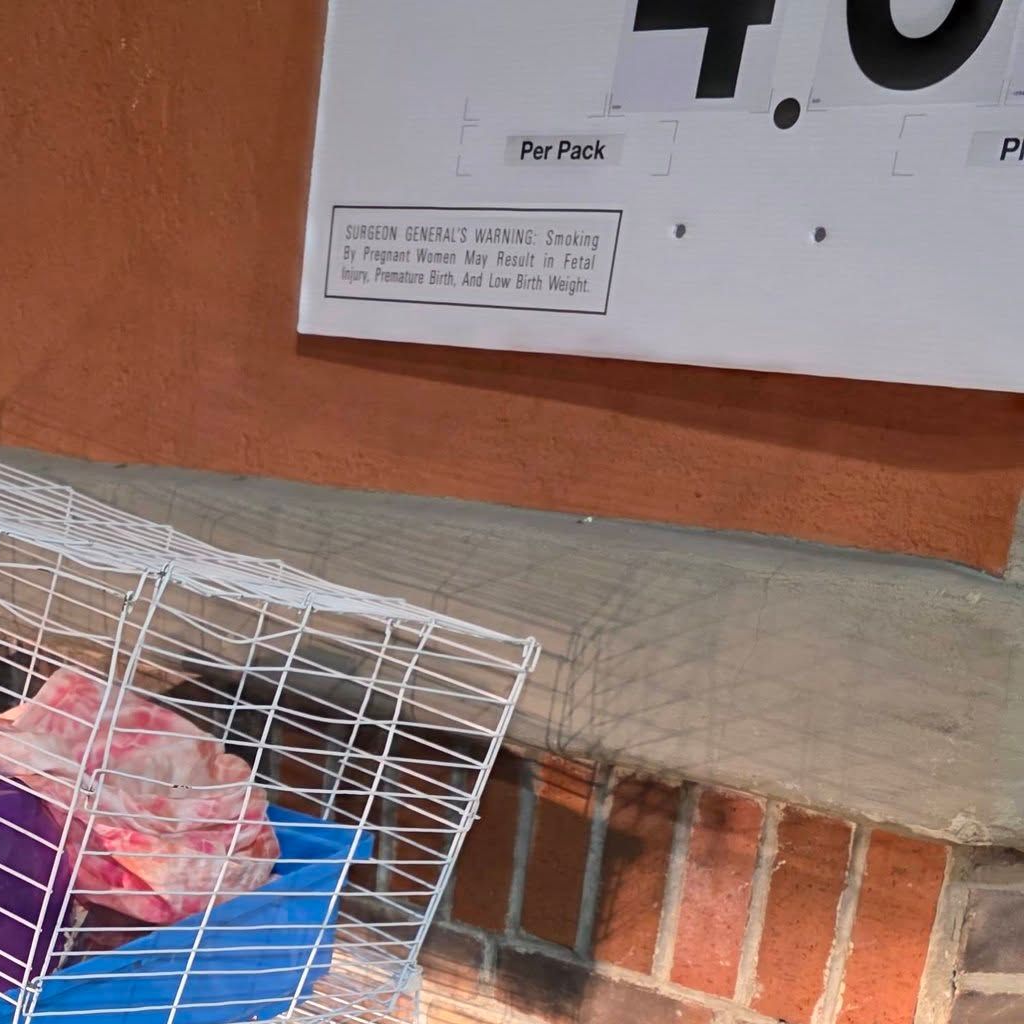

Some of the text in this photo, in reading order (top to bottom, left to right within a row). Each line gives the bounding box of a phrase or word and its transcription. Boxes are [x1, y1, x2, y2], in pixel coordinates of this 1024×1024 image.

[520, 139, 606, 161] Per Pack
[345, 224, 600, 251] SURGEON GENERAL'S WARNING: Smoking
[343, 246, 595, 271] By Pregnant Women May Result in Fetal
[341, 267, 592, 296] Injury, Premature Birth, And Low Birth Weight.
